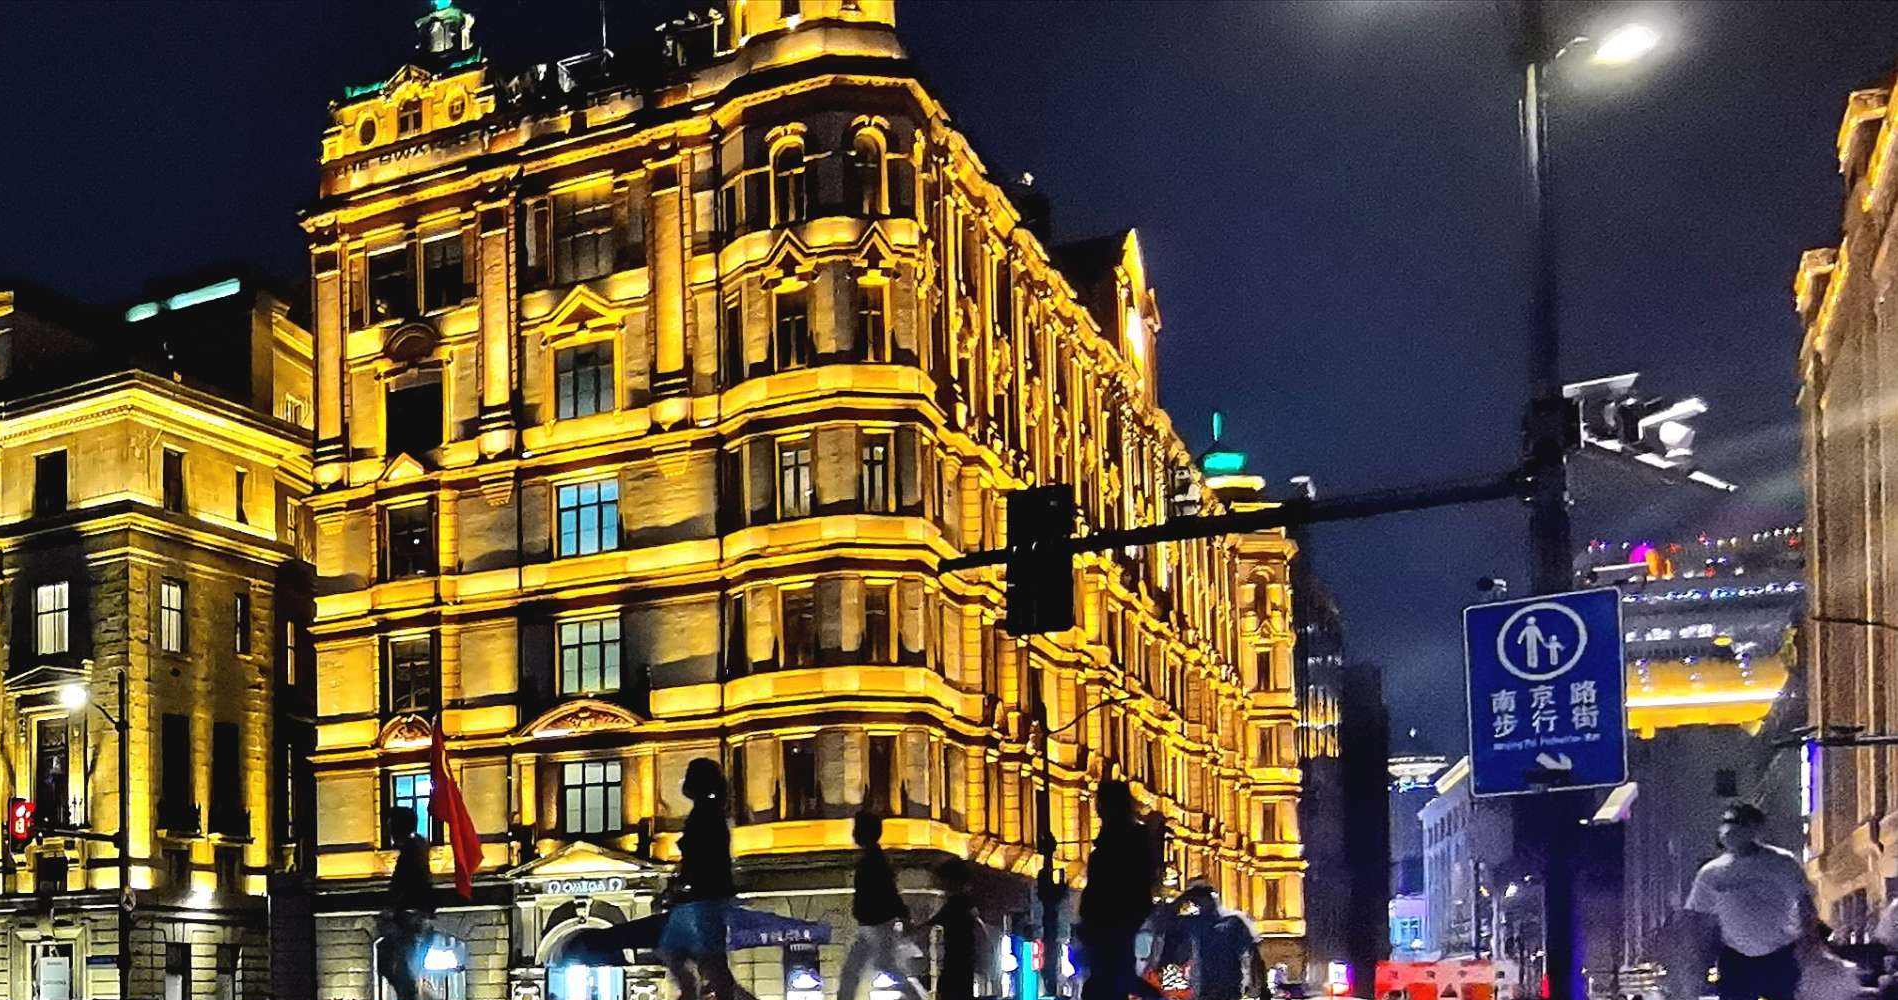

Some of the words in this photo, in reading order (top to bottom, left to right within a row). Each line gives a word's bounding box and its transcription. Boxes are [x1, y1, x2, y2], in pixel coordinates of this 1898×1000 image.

[1490, 679, 1597, 714] 南京路
[1492, 704, 1600, 739] 步行街
